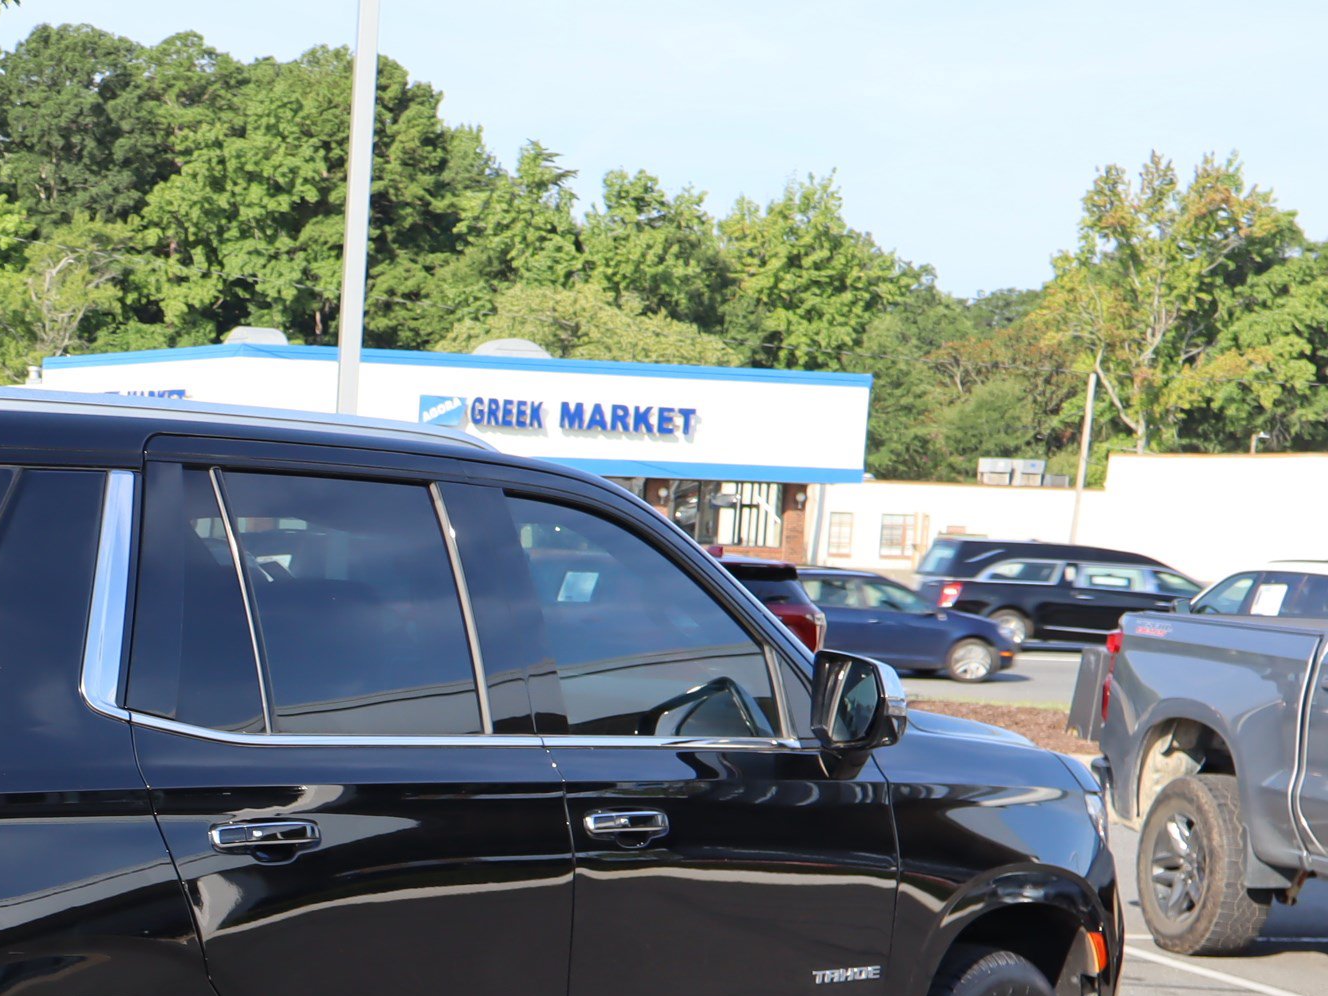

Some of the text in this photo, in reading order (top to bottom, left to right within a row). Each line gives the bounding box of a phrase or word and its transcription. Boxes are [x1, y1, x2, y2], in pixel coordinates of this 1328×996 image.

[471, 397, 696, 435] GREEK MARKET
[812, 965, 881, 985] TAHOE
